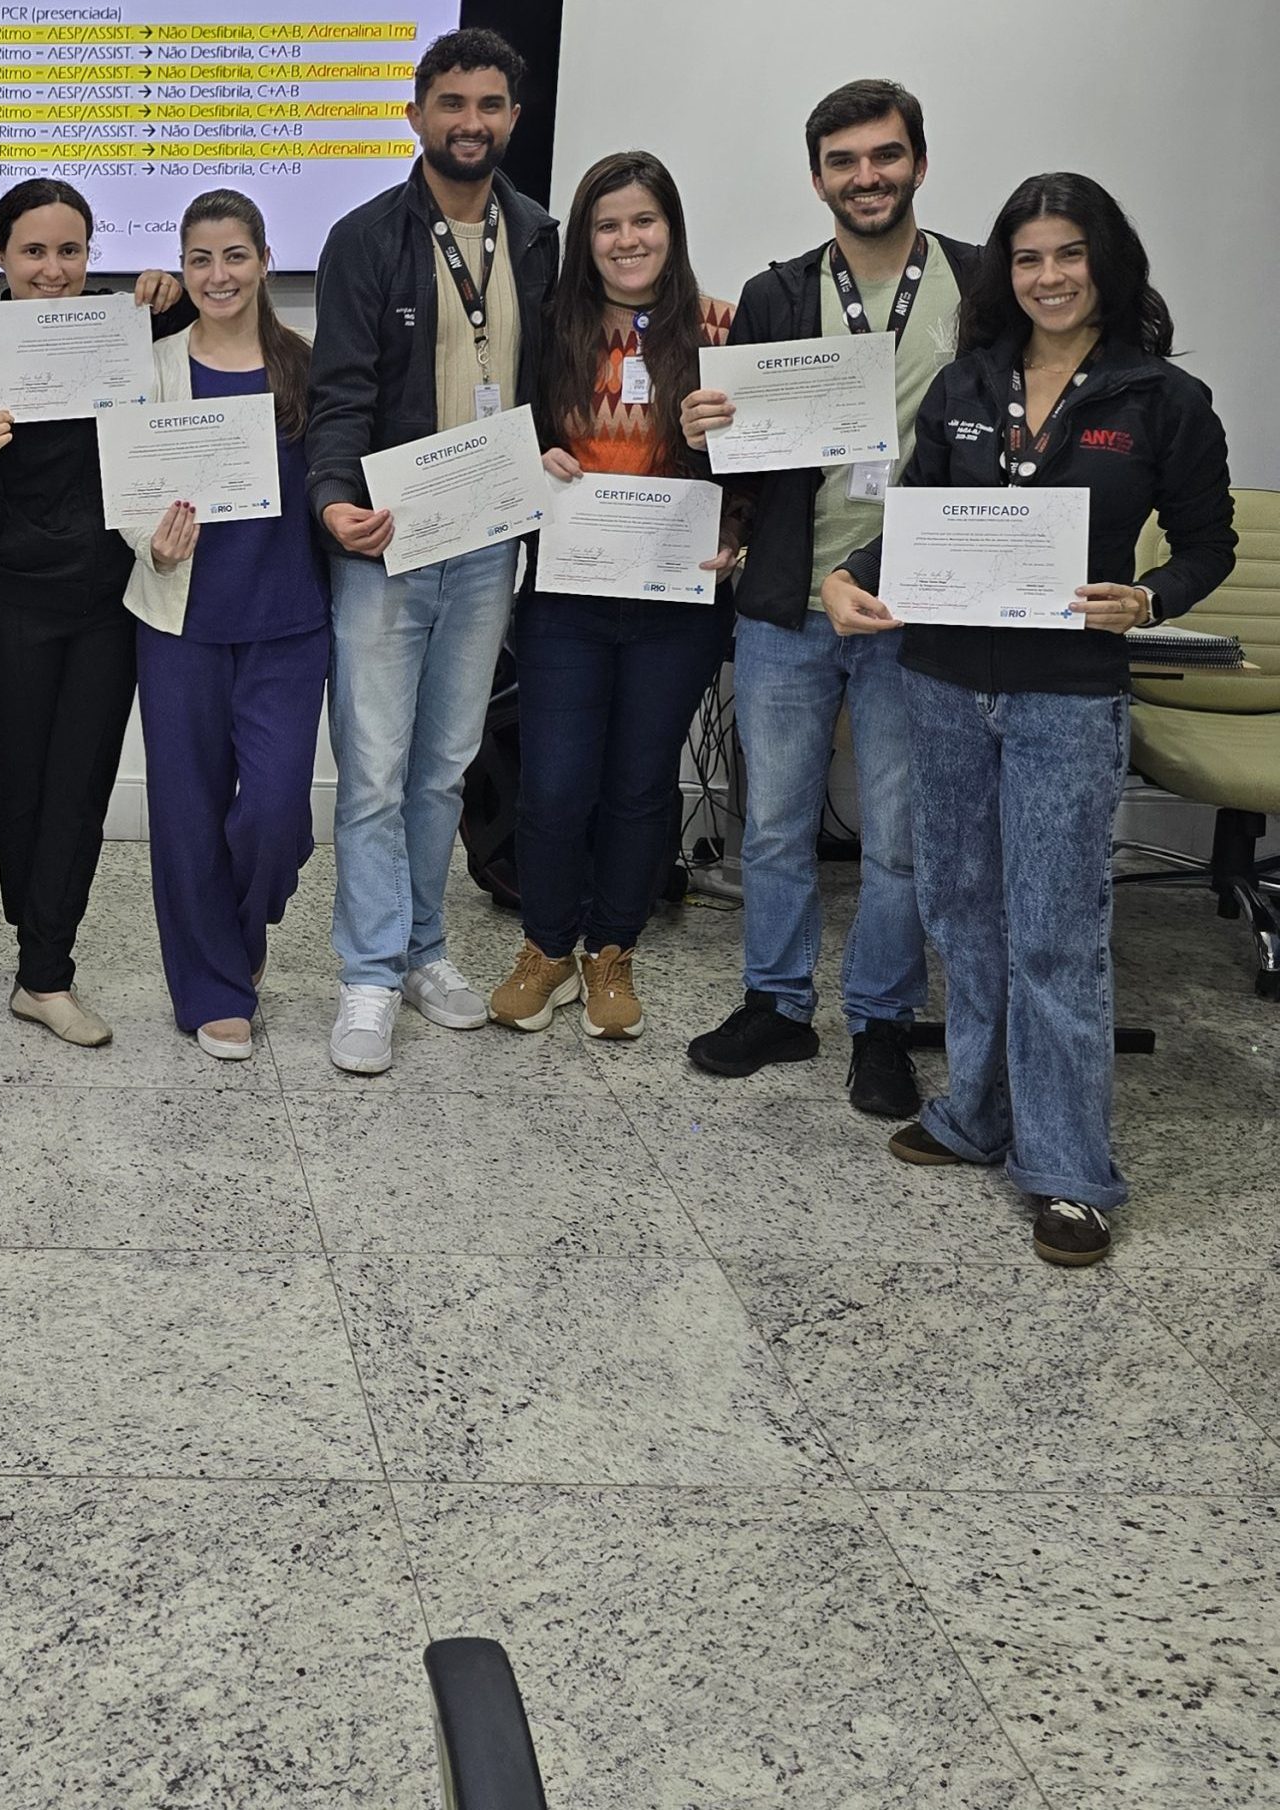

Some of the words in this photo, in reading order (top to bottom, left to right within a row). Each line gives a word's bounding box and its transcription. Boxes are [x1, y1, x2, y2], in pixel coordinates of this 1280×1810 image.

[2, 7, 28, 20] PCR
[32, 6, 122, 22] (presenciada)
[47, 27, 134, 42] AESP/ASSIST.
[158, 26, 187, 38] Não
[191, 26, 255, 40] Desfibrila,
[307, 24, 381, 37] Adrenalina
[388, 24, 416, 39] 1mg
[47, 47, 134, 62] AESP/ASSIST.
[158, 46, 186, 58] Não
[191, 45, 254, 59] Desfibrila,
[47, 66, 134, 81] AESP/ASSIST.
[157, 65, 186, 77] Não
[190, 65, 254, 79] Desfibrila,
[306, 64, 380, 76] Adrenalina
[386, 63, 415, 78] 1mg
[47, 86, 134, 101] AESP/ASSIST.
[157, 85, 186, 97] Não
[190, 84, 253, 98] Desfibrila,
[47, 105, 134, 120] AESP/ASSIST.
[157, 104, 185, 116] Não
[190, 104, 253, 118] Desfibrila,
[304, 103, 378, 115] Adrenalina
[384, 102, 405, 114] 1m
[52, 124, 138, 140] AESP/ASSIST.
[161, 124, 189, 136] Não
[193, 123, 256, 137] Desfibrila,
[52, 144, 137, 159] AESP/ASSIST.
[161, 143, 189, 155] Não
[193, 142, 255, 156] Desfibrila,
[308, 141, 381, 154] Adrenalina
[387, 141, 415, 156] 1mg
[0, 164, 36, 176] Ritmo
[52, 163, 137, 178] AESP/ASSIST.
[160, 162, 188, 174] Não
[193, 162, 255, 176] Desfibrila,
[144, 220, 177, 232] cada
[37, 311, 106, 324] CERTIFICADO
[757, 353, 840, 370] CERTIFICADO
[149, 414, 225, 429] CERTIFICADO
[415, 435, 488, 466] CERTIFICADO
[830, 447, 846, 457] RIO
[595, 489, 671, 503] CERTIFICADO
[217, 505, 233, 514] RIO
[942, 505, 1030, 516] CERTIFICADO
[651, 584, 666, 592] RIO
[1008, 609, 1026, 618] RIO
